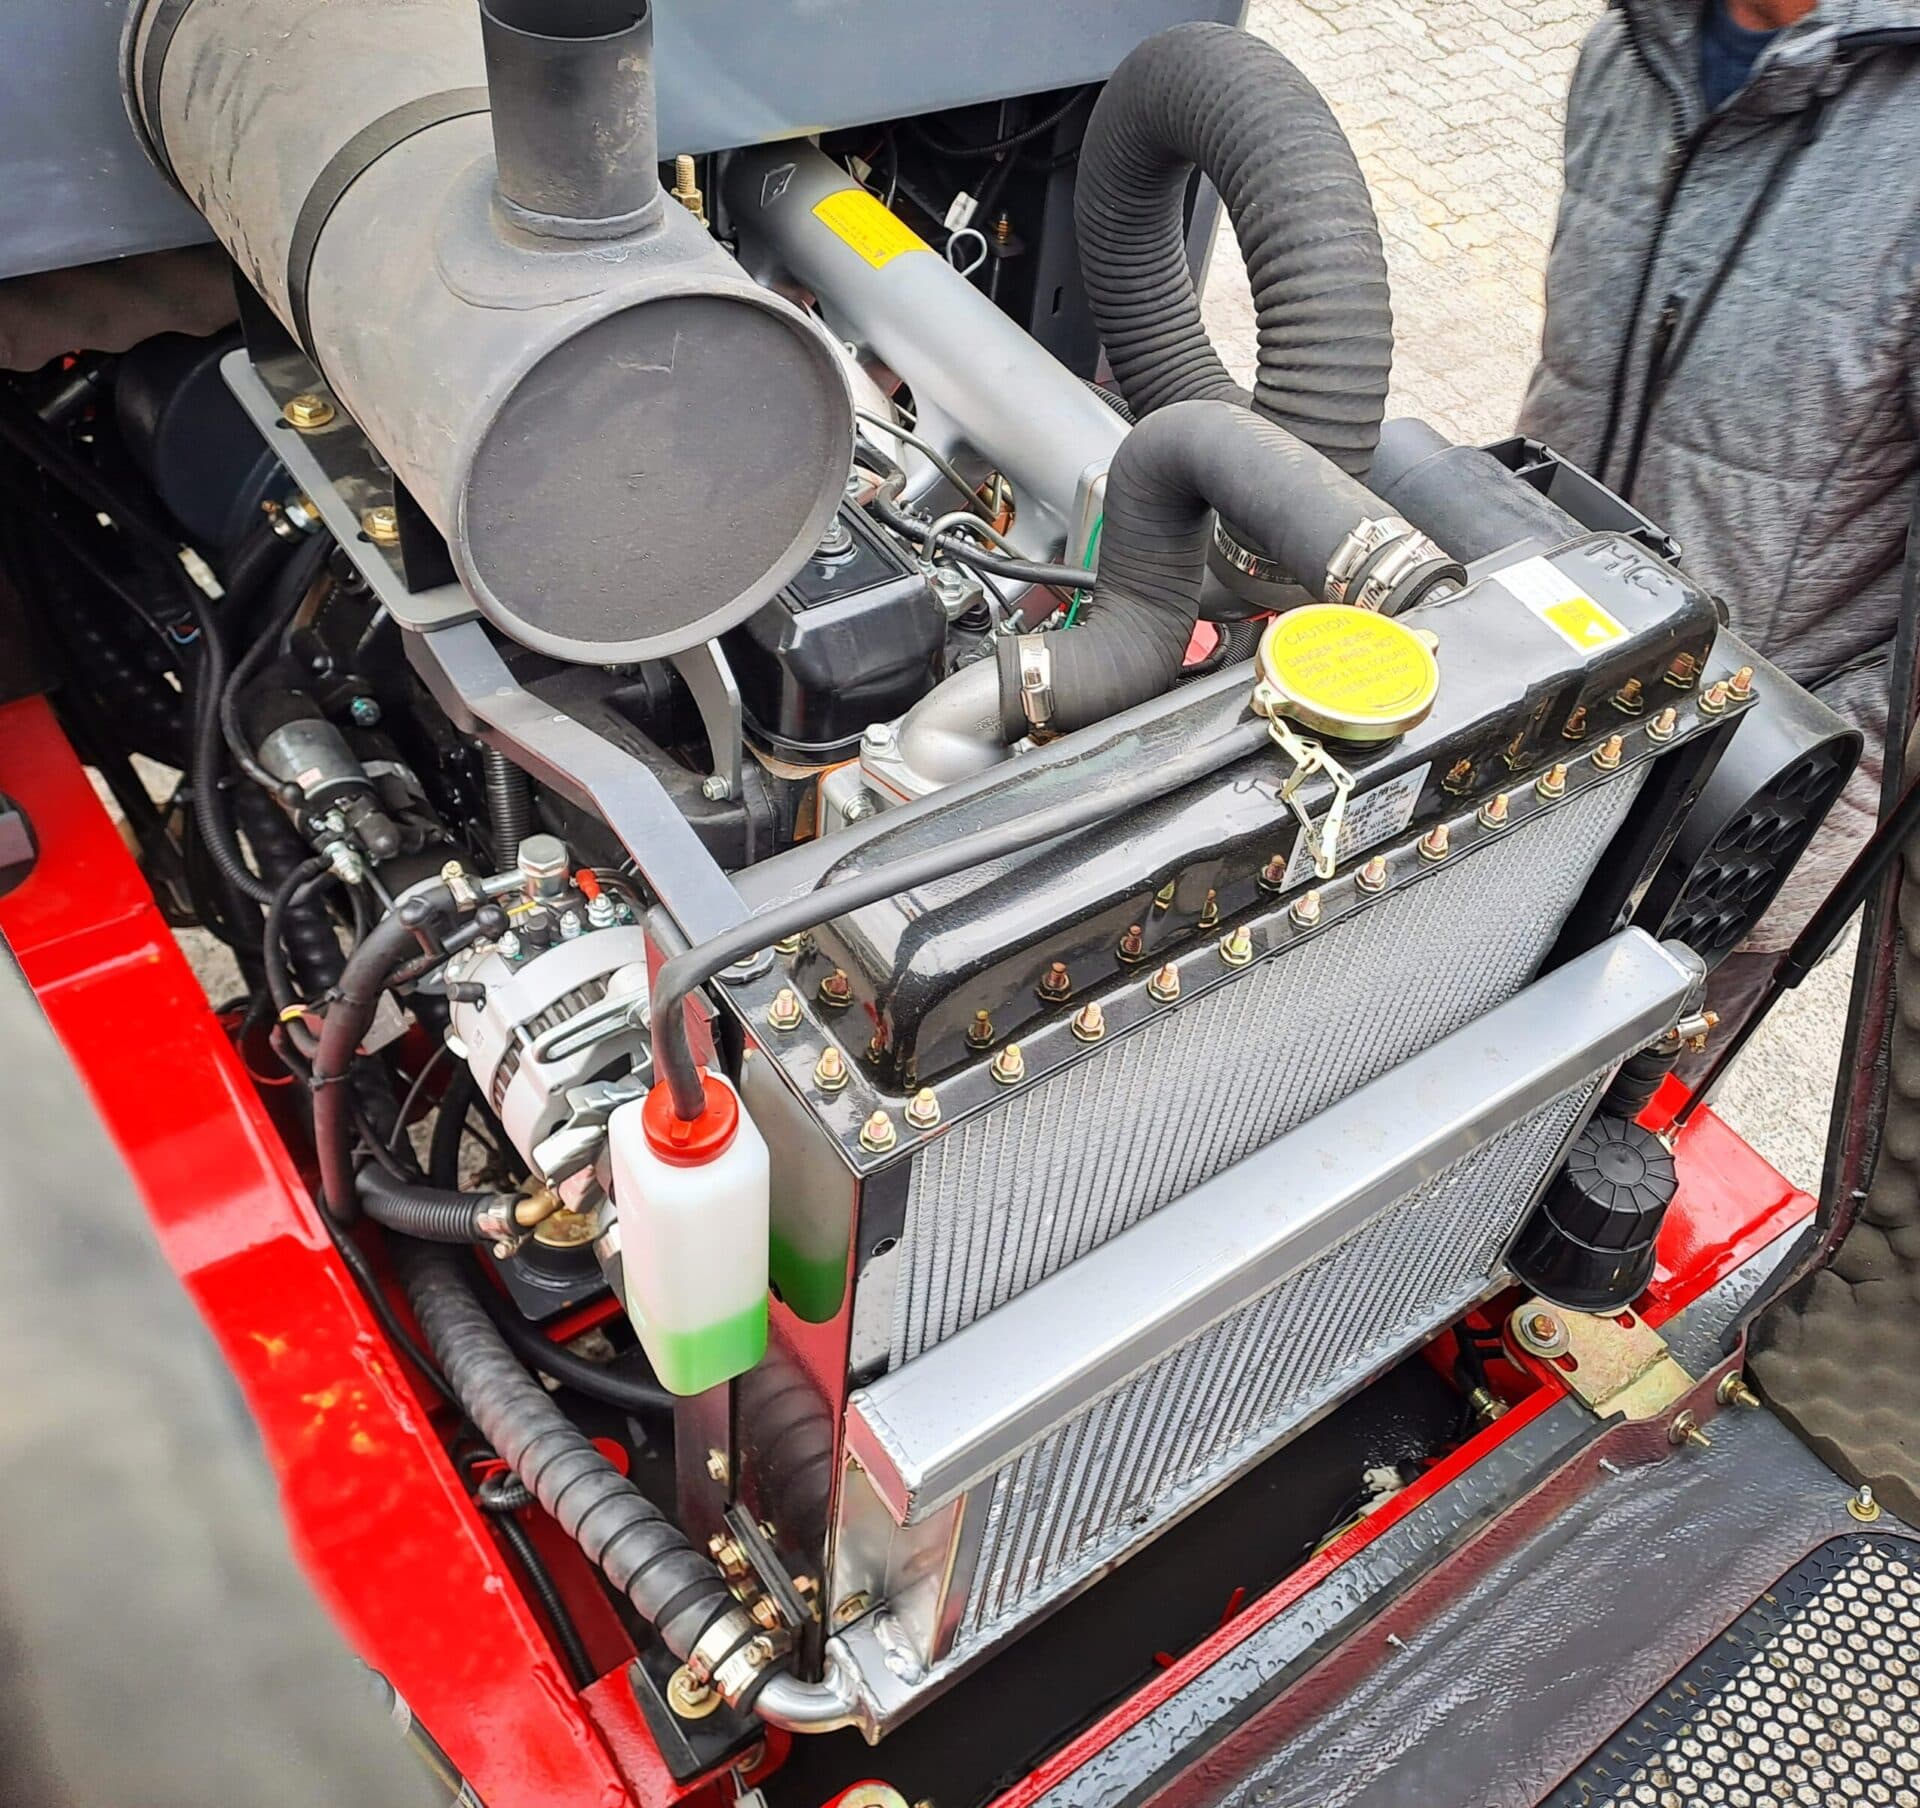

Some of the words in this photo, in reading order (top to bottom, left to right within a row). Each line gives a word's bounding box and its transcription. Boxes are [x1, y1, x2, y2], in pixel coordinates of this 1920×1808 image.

[1284, 616, 1351, 646] CAUTION
[1286, 644, 1332, 668] DANGER
[1336, 630, 1375, 651] NEVER
[1298, 660, 1331, 679] OPEN
[1336, 646, 1370, 664] WHEN
[1373, 635, 1396, 652] HOT
